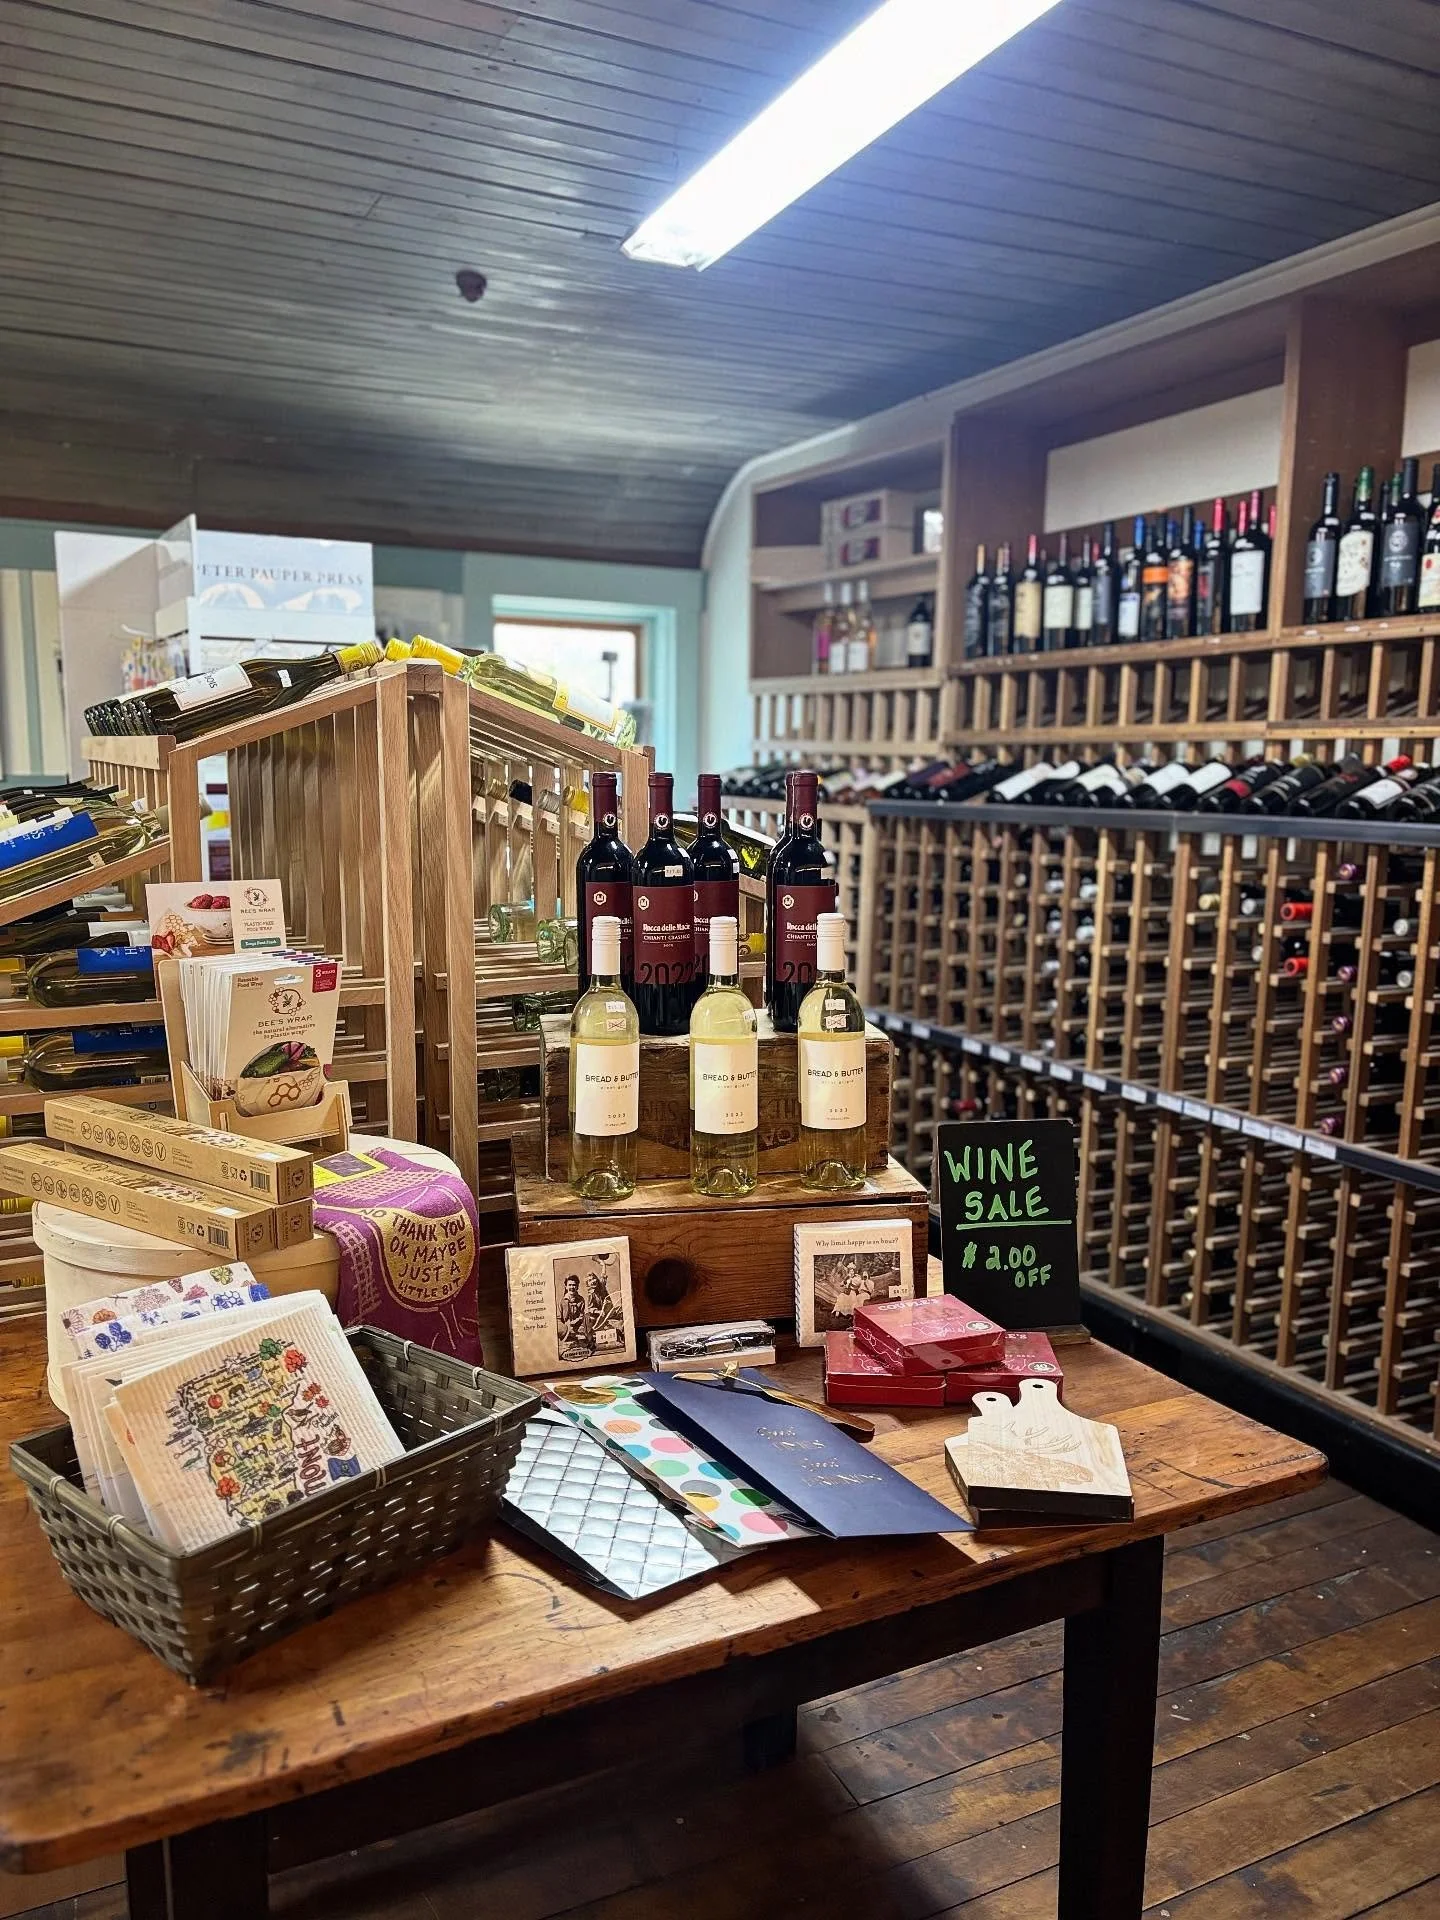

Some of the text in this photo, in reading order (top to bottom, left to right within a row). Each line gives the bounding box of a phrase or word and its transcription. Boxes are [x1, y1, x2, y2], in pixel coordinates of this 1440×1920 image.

[197, 563, 364, 586] ETER PAUPER PRESS
[642, 923, 661, 932] Rocca
[661, 923, 676, 931] delle
[786, 921, 818, 931] Rocca dell
[315, 968, 322, 978] 3
[287, 1014, 313, 1024] WRAP
[264, 1025, 285, 1034] natural
[270, 1031, 290, 1040] plastic
[702, 1073, 729, 1082] BREAD
[730, 1074, 736, 1082] &
[807, 1068, 833, 1078] BREAD
[834, 1070, 839, 1078] &
[585, 1074, 612, 1083] BREAD
[613, 1075, 619, 1083] &
[943, 1139, 1039, 1184] WINE
[964, 1185, 1050, 1221] SALE
[360, 1208, 466, 1242] NO THANK YOU
[847, 1238, 865, 1247] happy
[880, 1236, 899, 1244] hour?
[390, 1235, 467, 1263] OK MAYBE
[398, 1259, 461, 1283] JUST A
[1014, 1263, 1052, 1288] OFF
[398, 1277, 462, 1298] LITTLE BIT
[520, 1280, 546, 1288] birthday
[523, 1324, 535, 1332] they
